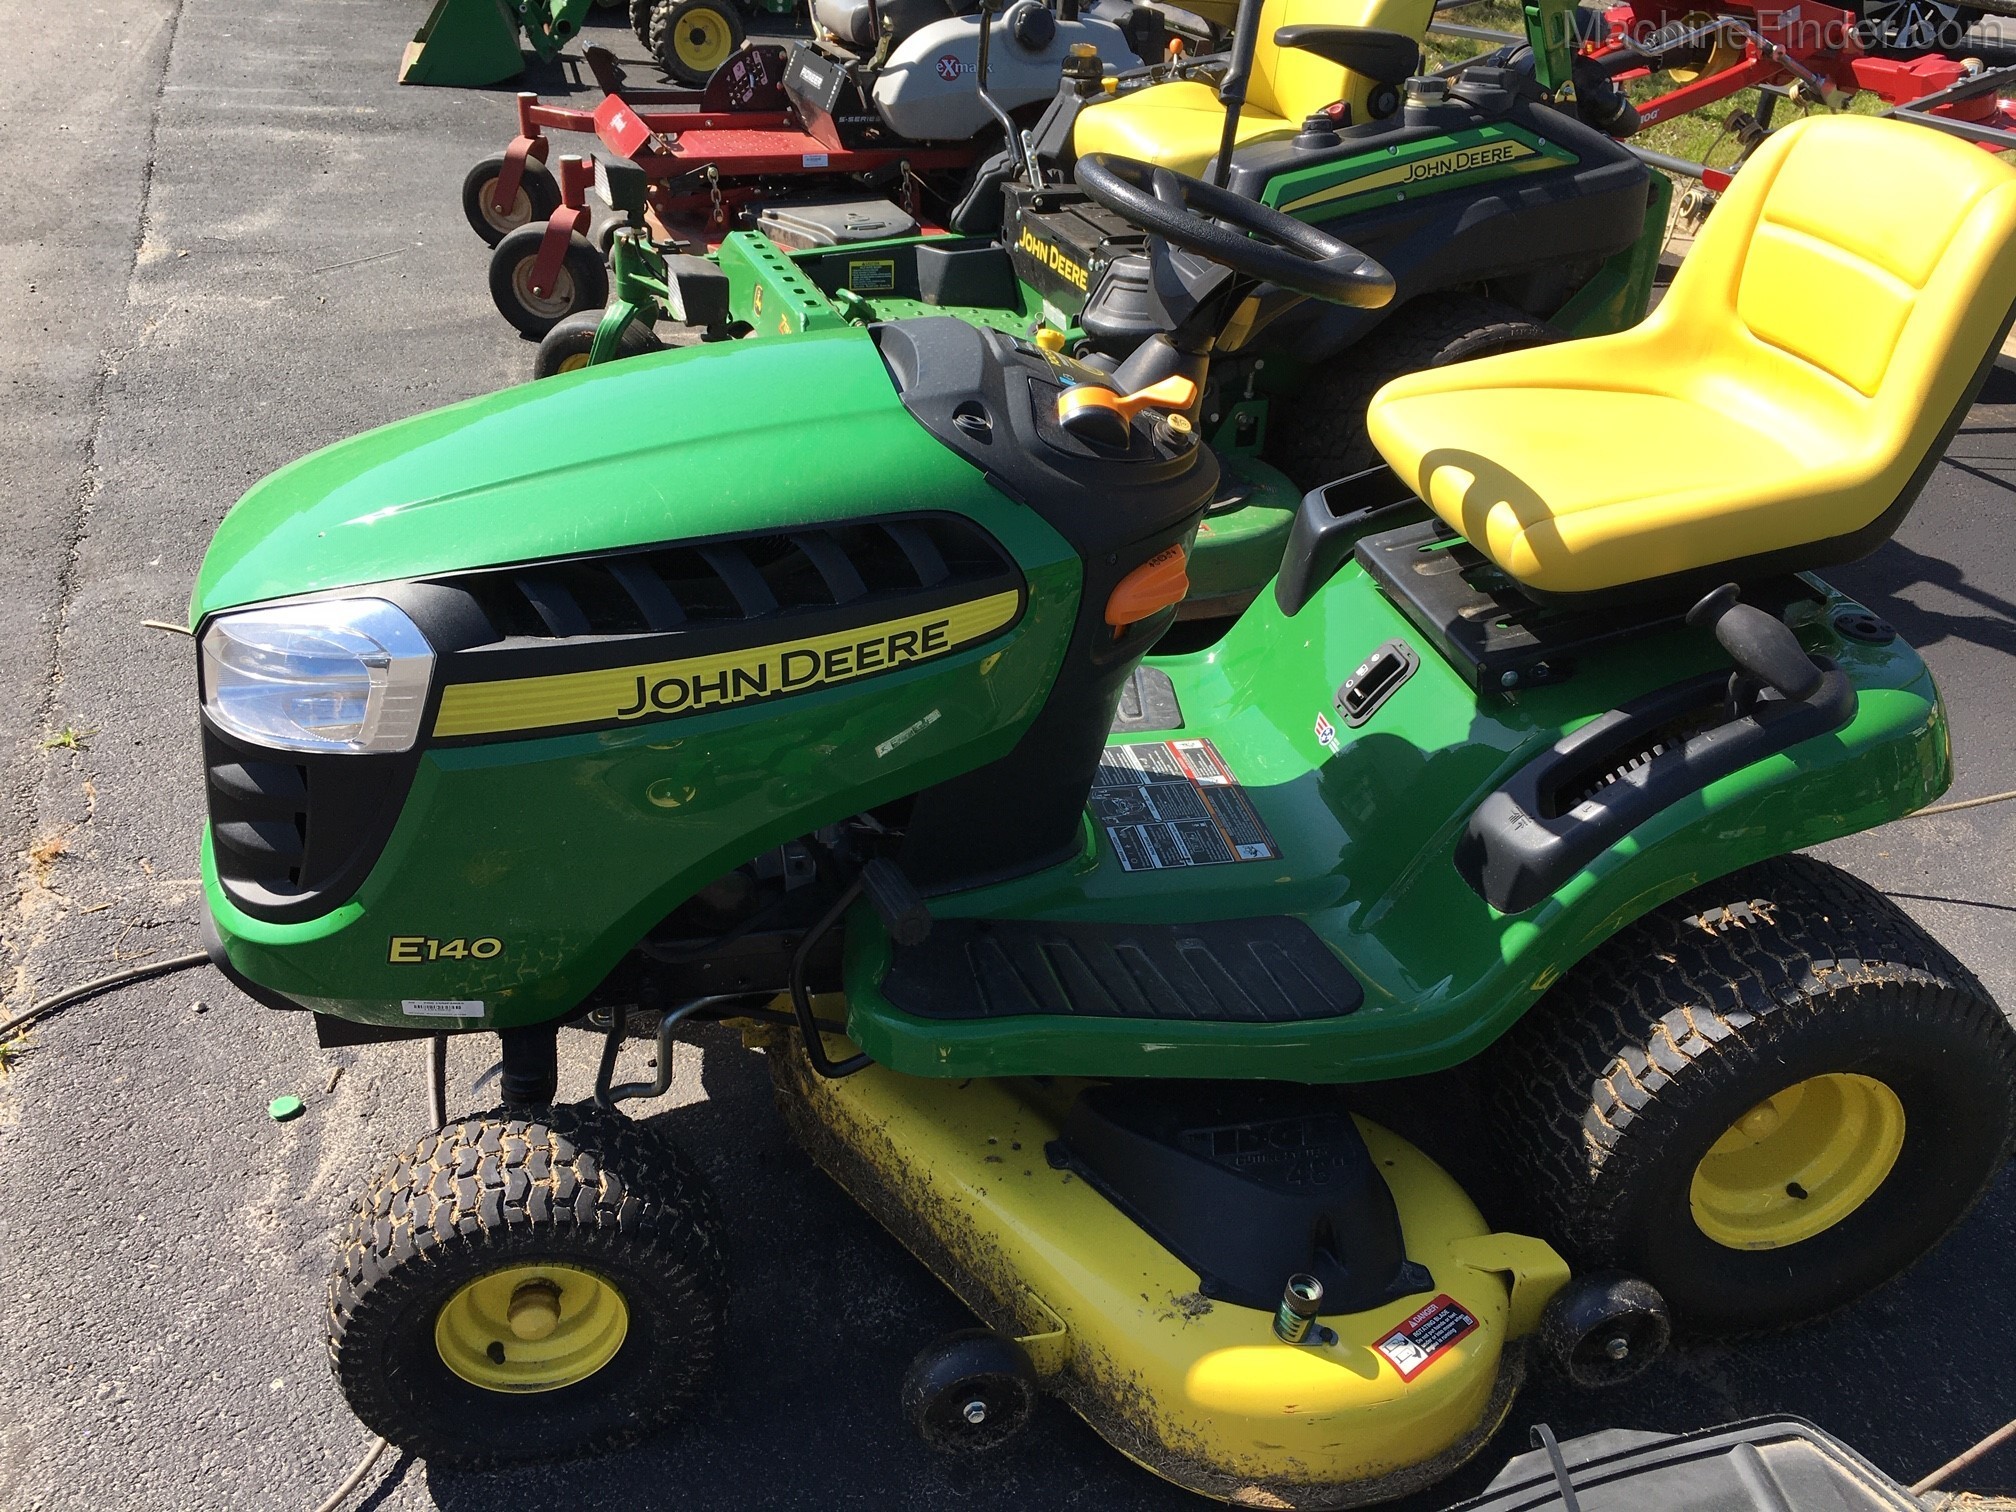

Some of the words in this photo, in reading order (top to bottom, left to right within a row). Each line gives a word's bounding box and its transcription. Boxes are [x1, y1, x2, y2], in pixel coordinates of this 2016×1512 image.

[1403, 159, 1452, 181] JOHN
[1456, 145, 1513, 169] DEERE
[1019, 225, 1048, 264] JOHN
[1049, 244, 1089, 291] DEERE
[617, 663, 767, 716] JOHN
[781, 619, 950, 688] DEERE
[389, 937, 502, 962] E140
[1412, 1303, 1439, 1323] DANGER
[1412, 1319, 1436, 1338] ROTATING
[1433, 1309, 1450, 1322] BLADE
